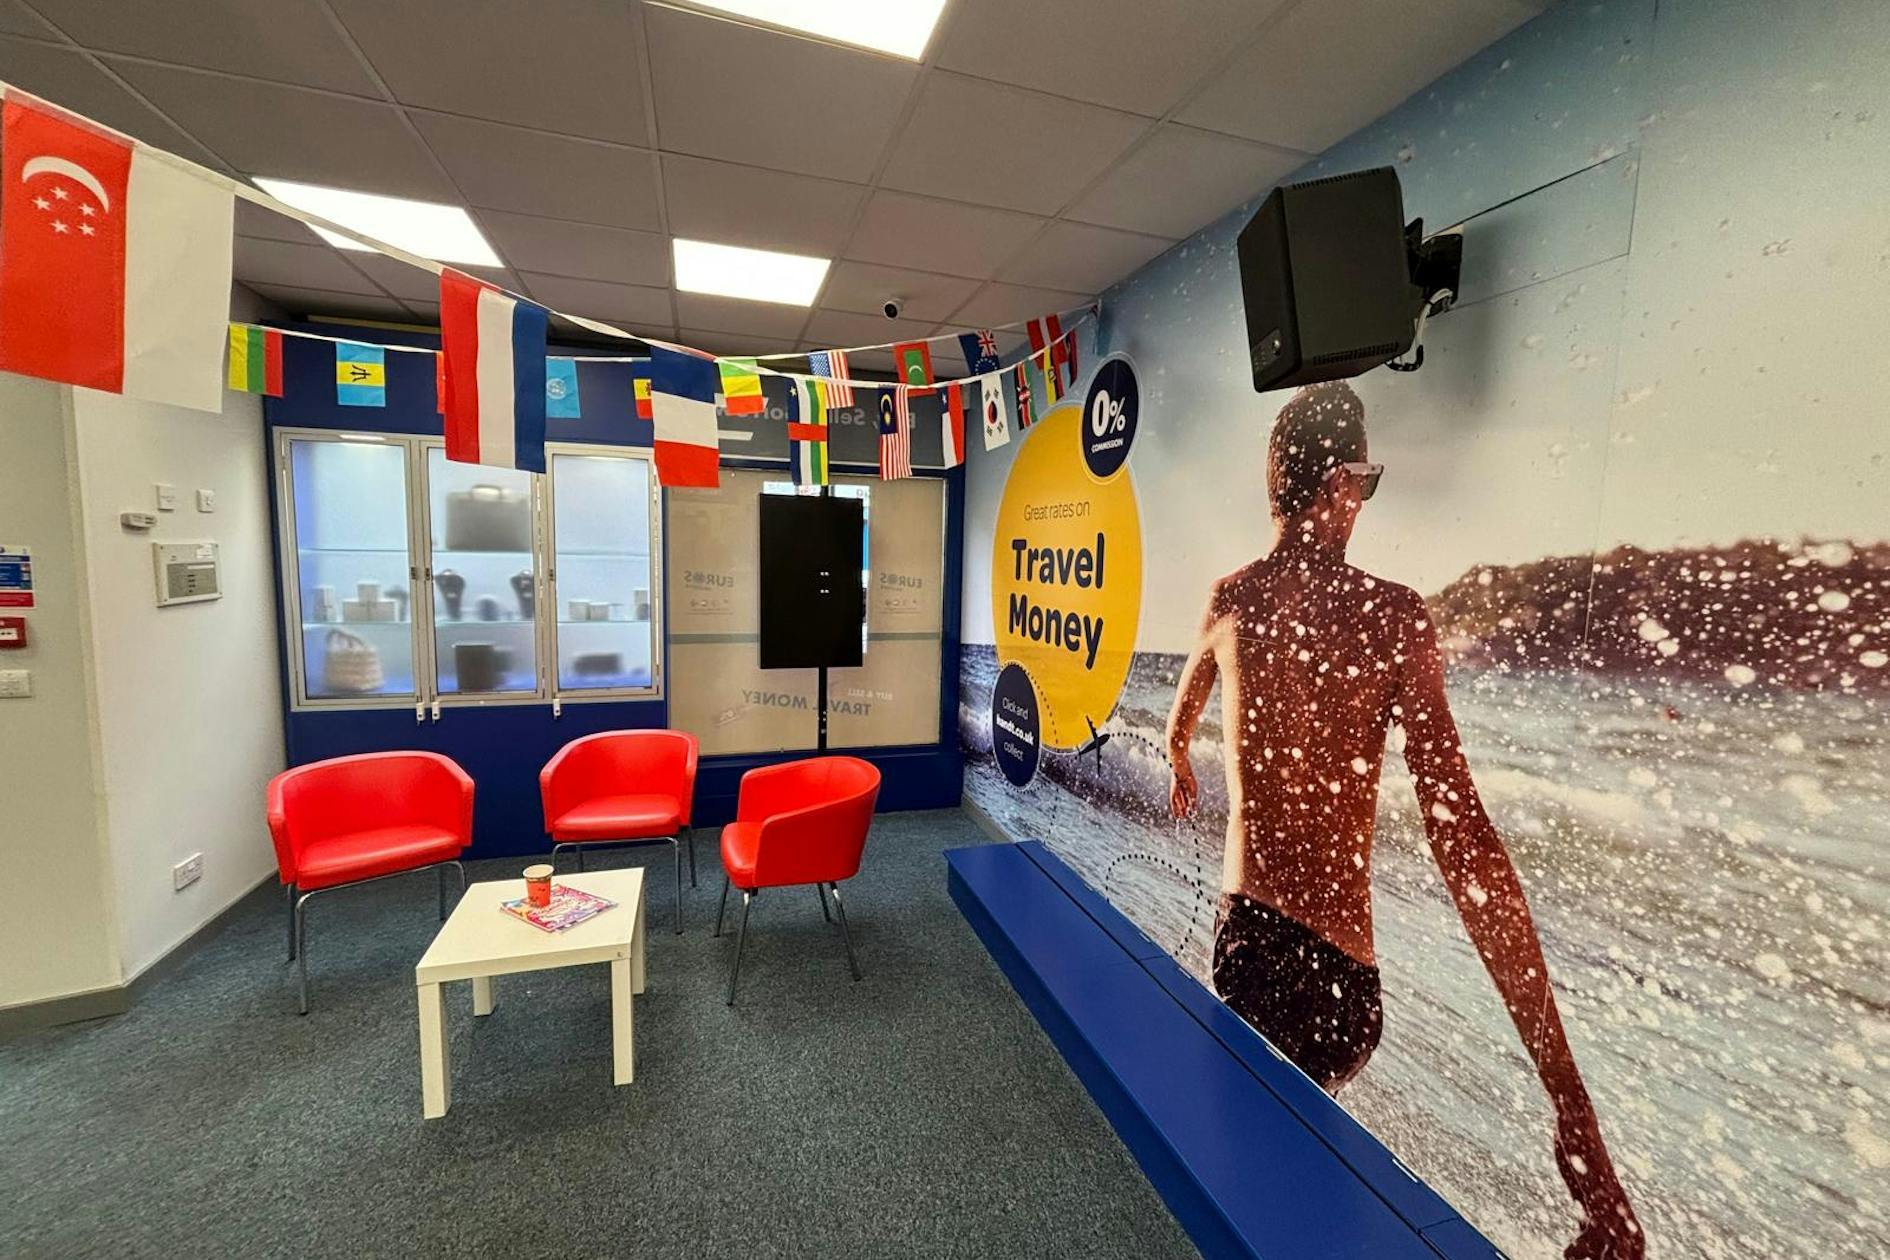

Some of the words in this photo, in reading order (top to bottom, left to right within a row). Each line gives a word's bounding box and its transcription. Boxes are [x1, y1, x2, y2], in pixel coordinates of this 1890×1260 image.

[1091, 388, 1126, 437] 0%
[1091, 437, 1125, 453] COMMISSION
[1024, 504, 1048, 521] Great
[1049, 502, 1075, 520] rates
[1075, 500, 1090, 517] on
[1011, 532, 1105, 589] Travel
[1008, 592, 1104, 670] Money
[1002, 697, 1016, 713] Click
[1016, 706, 1029, 720] and
